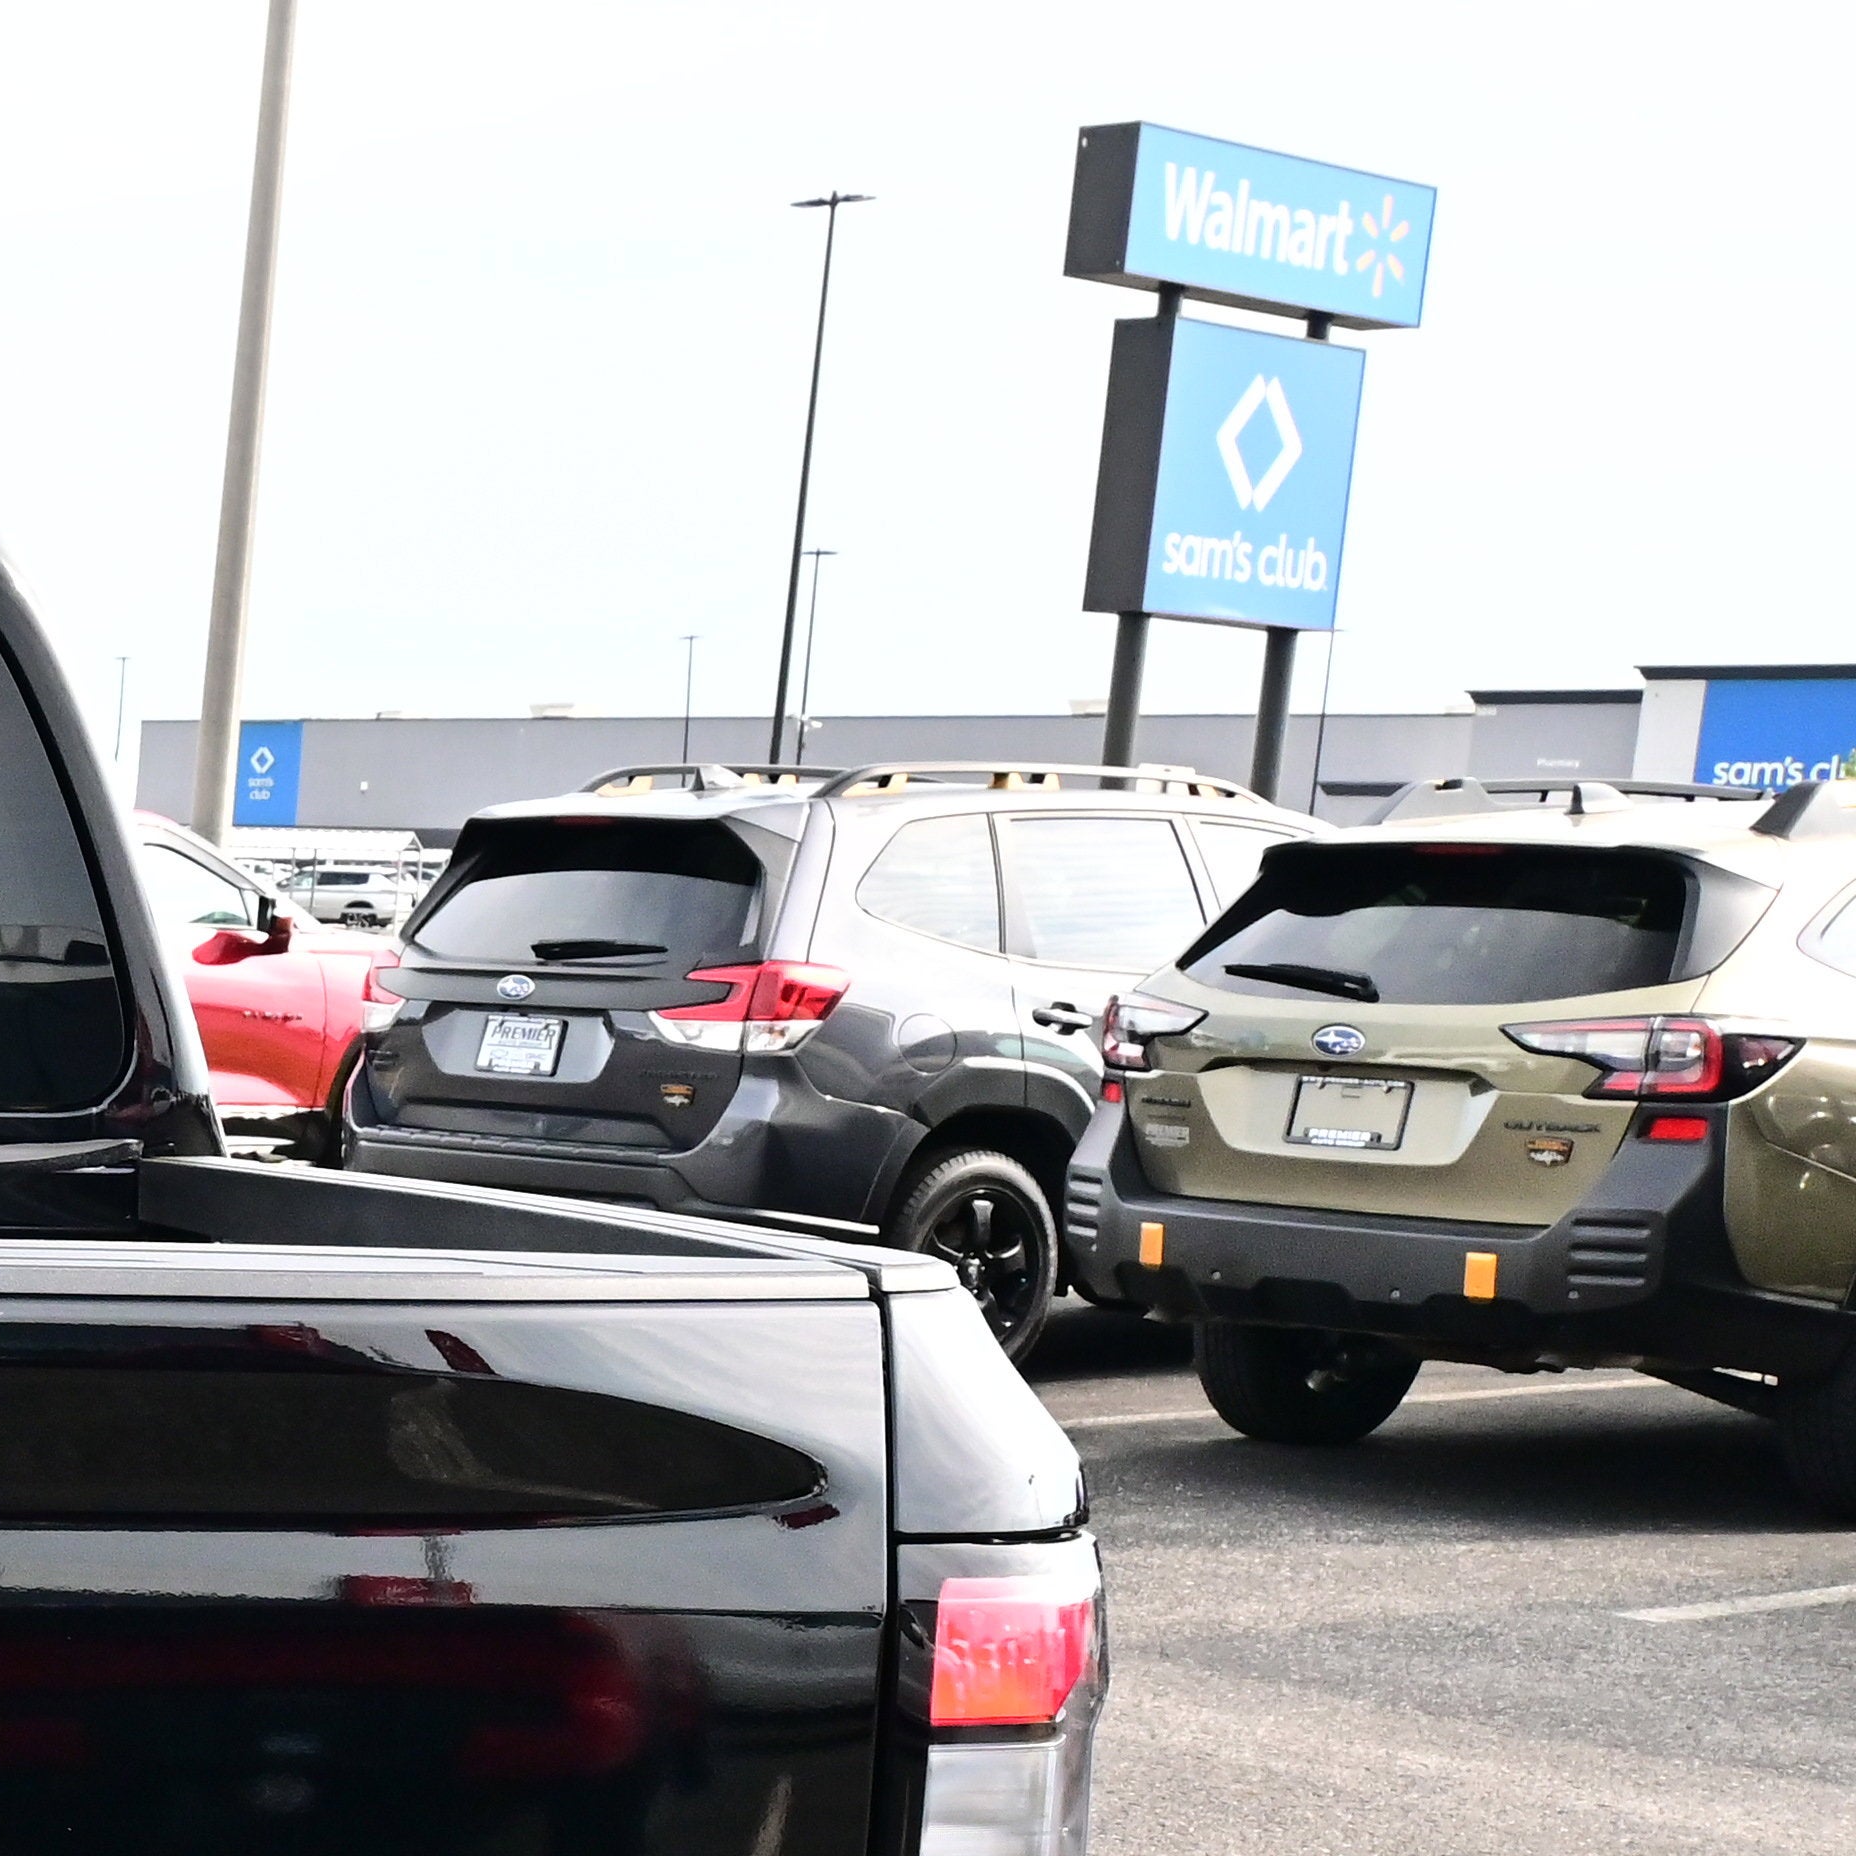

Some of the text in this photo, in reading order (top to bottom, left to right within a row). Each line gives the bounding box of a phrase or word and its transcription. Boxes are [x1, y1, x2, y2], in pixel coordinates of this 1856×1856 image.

[1164, 161, 1354, 276] Walmart
[1162, 530, 1253, 584] sam's
[1712, 756, 1804, 786] sam's
[491, 1025, 557, 1043] PREMIER
